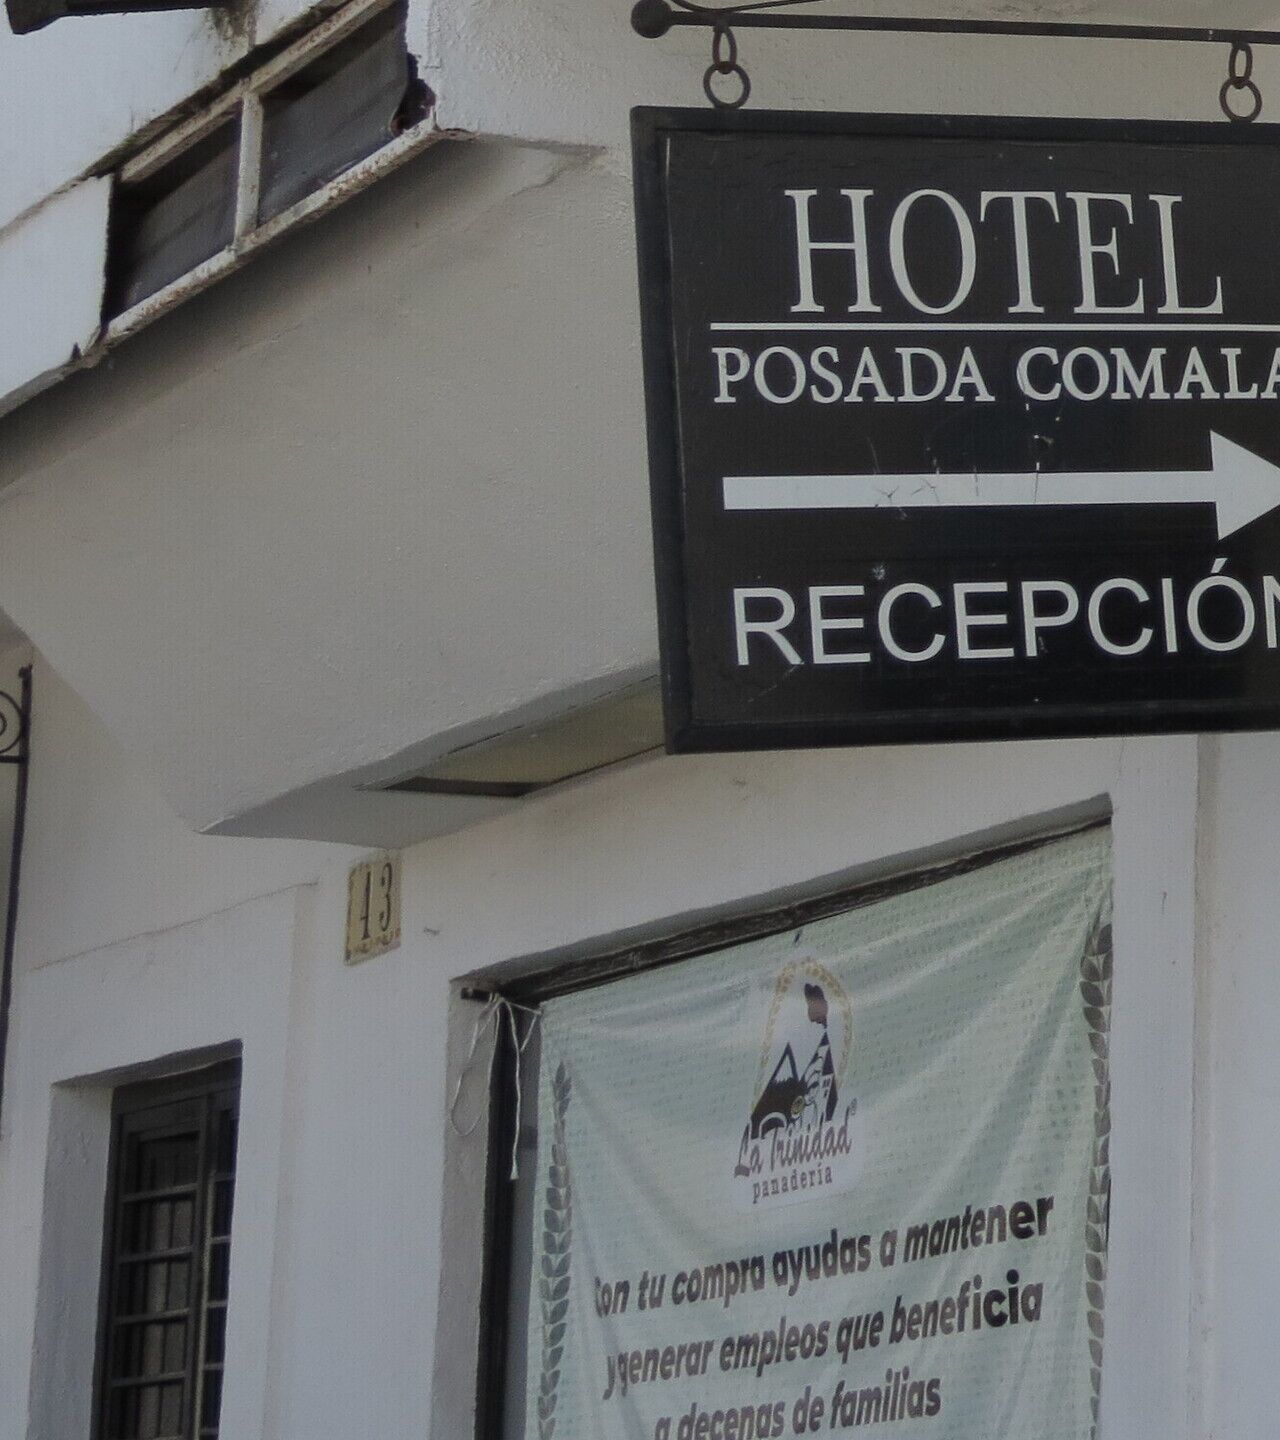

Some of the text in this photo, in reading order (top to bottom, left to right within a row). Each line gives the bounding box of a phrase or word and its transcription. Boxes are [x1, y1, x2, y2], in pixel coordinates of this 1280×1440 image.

[784, 188, 1224, 315] HOTEL
[711, 346, 996, 404] POSADA
[637, 1270, 667, 1311] tu
[671, 1254, 765, 1308] compra
[772, 1228, 872, 1296] ayudas
[879, 1229, 898, 1268] a
[903, 1195, 1054, 1262] mantener
[617, 1339, 714, 1398] generar
[719, 1315, 831, 1377] empleos
[836, 1310, 884, 1364] que
[889, 1268, 1044, 1345] beneficia
[676, 1402, 786, 1440] decenas
[792, 1385, 825, 1435] de
[830, 1365, 942, 1429] familias
